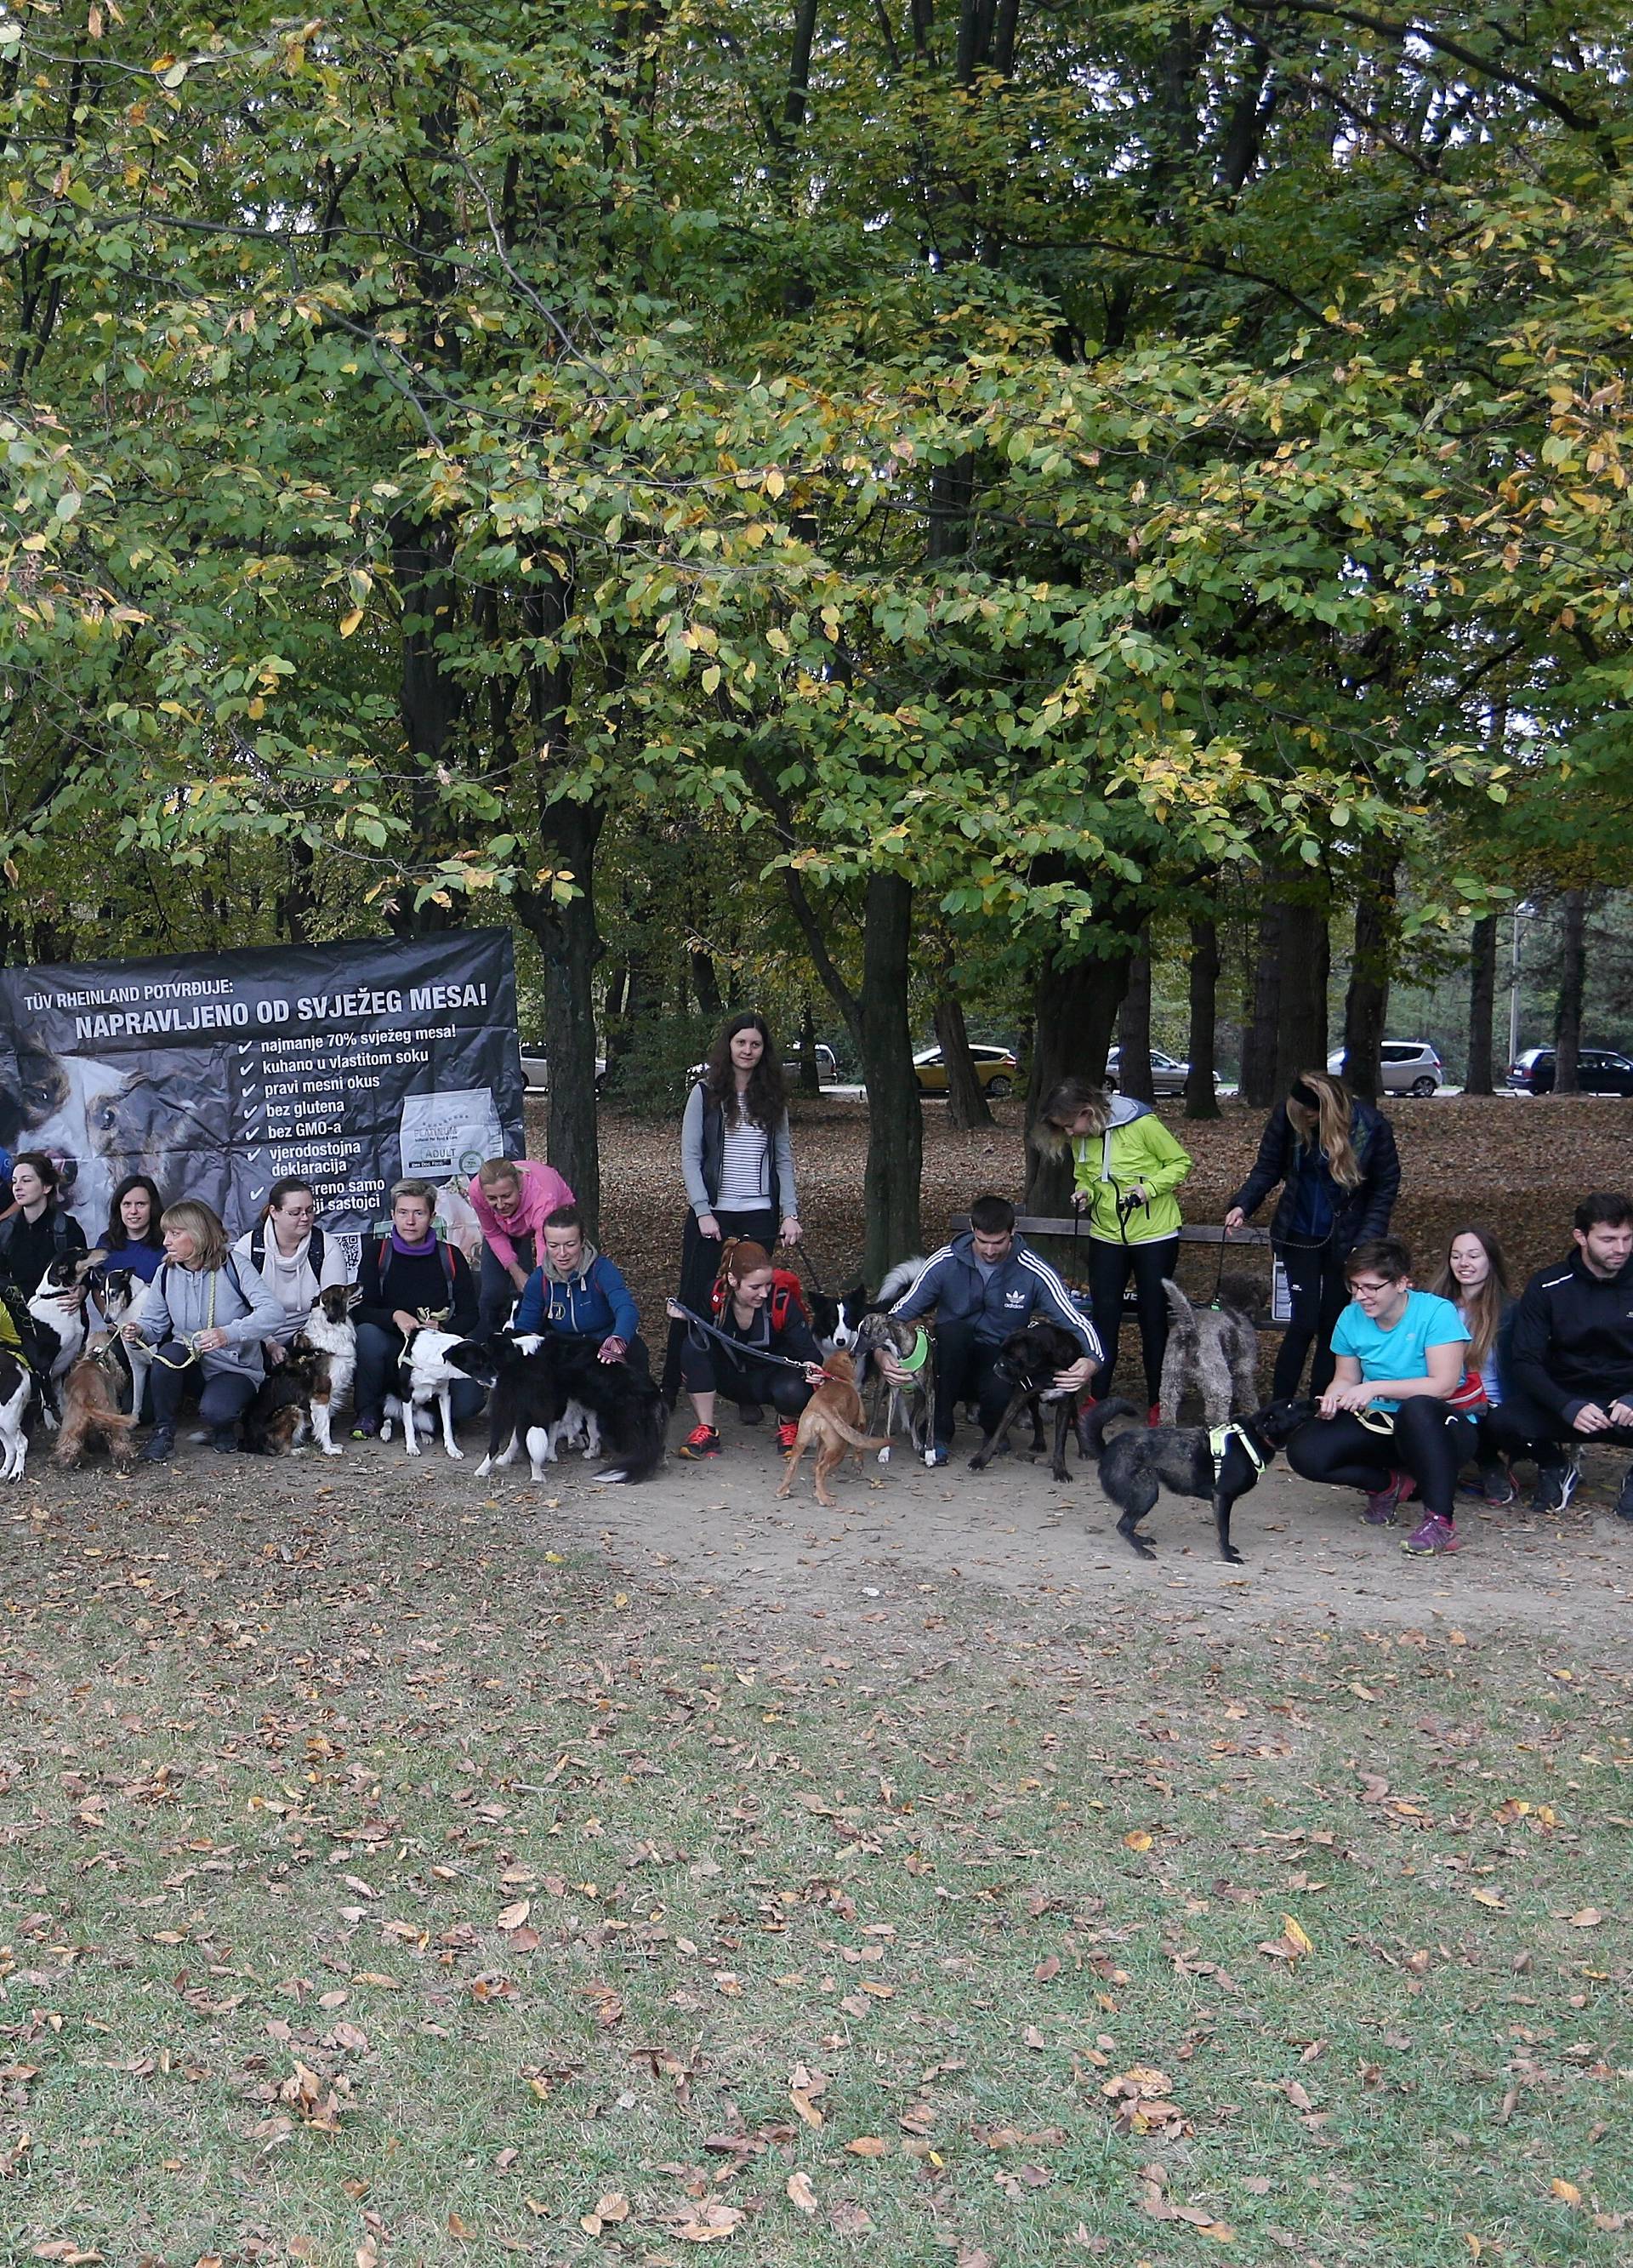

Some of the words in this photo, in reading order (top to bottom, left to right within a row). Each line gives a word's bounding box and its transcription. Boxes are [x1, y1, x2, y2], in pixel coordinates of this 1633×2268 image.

[24, 993, 53, 1011] TÜV
[57, 987, 139, 1008] RHEINLAND
[144, 979, 234, 1001] POTVRĐUJE:
[75, 1002, 249, 1040] NAPRAVLJENO
[257, 1000, 289, 1024] OD
[298, 987, 402, 1021] SVJEŽEG
[410, 983, 487, 1011] MESA!
[261, 1036, 324, 1055] najmanje
[327, 1033, 357, 1048] 70%
[360, 1029, 412, 1047] svježeg
[415, 1023, 457, 1041] mesa!
[262, 1059, 314, 1075] kuhano
[317, 1058, 327, 1070] u
[328, 1052, 392, 1070] vlastitom
[395, 1048, 430, 1064] soku
[265, 1079, 299, 1099] pravi
[302, 1075, 344, 1094] mesni
[347, 1074, 381, 1089] okus
[266, 1103, 291, 1118] bez
[293, 1100, 345, 1119] glutena
[268, 1125, 293, 1139] bez
[295, 1120, 342, 1137] GMO-a
[269, 1140, 361, 1162] vjerodostojna
[425, 1148, 456, 1158] ADULT
[271, 1158, 347, 1177] deklaracija
[348, 1179, 385, 1194] samo
[327, 1194, 380, 1212] sastojci
